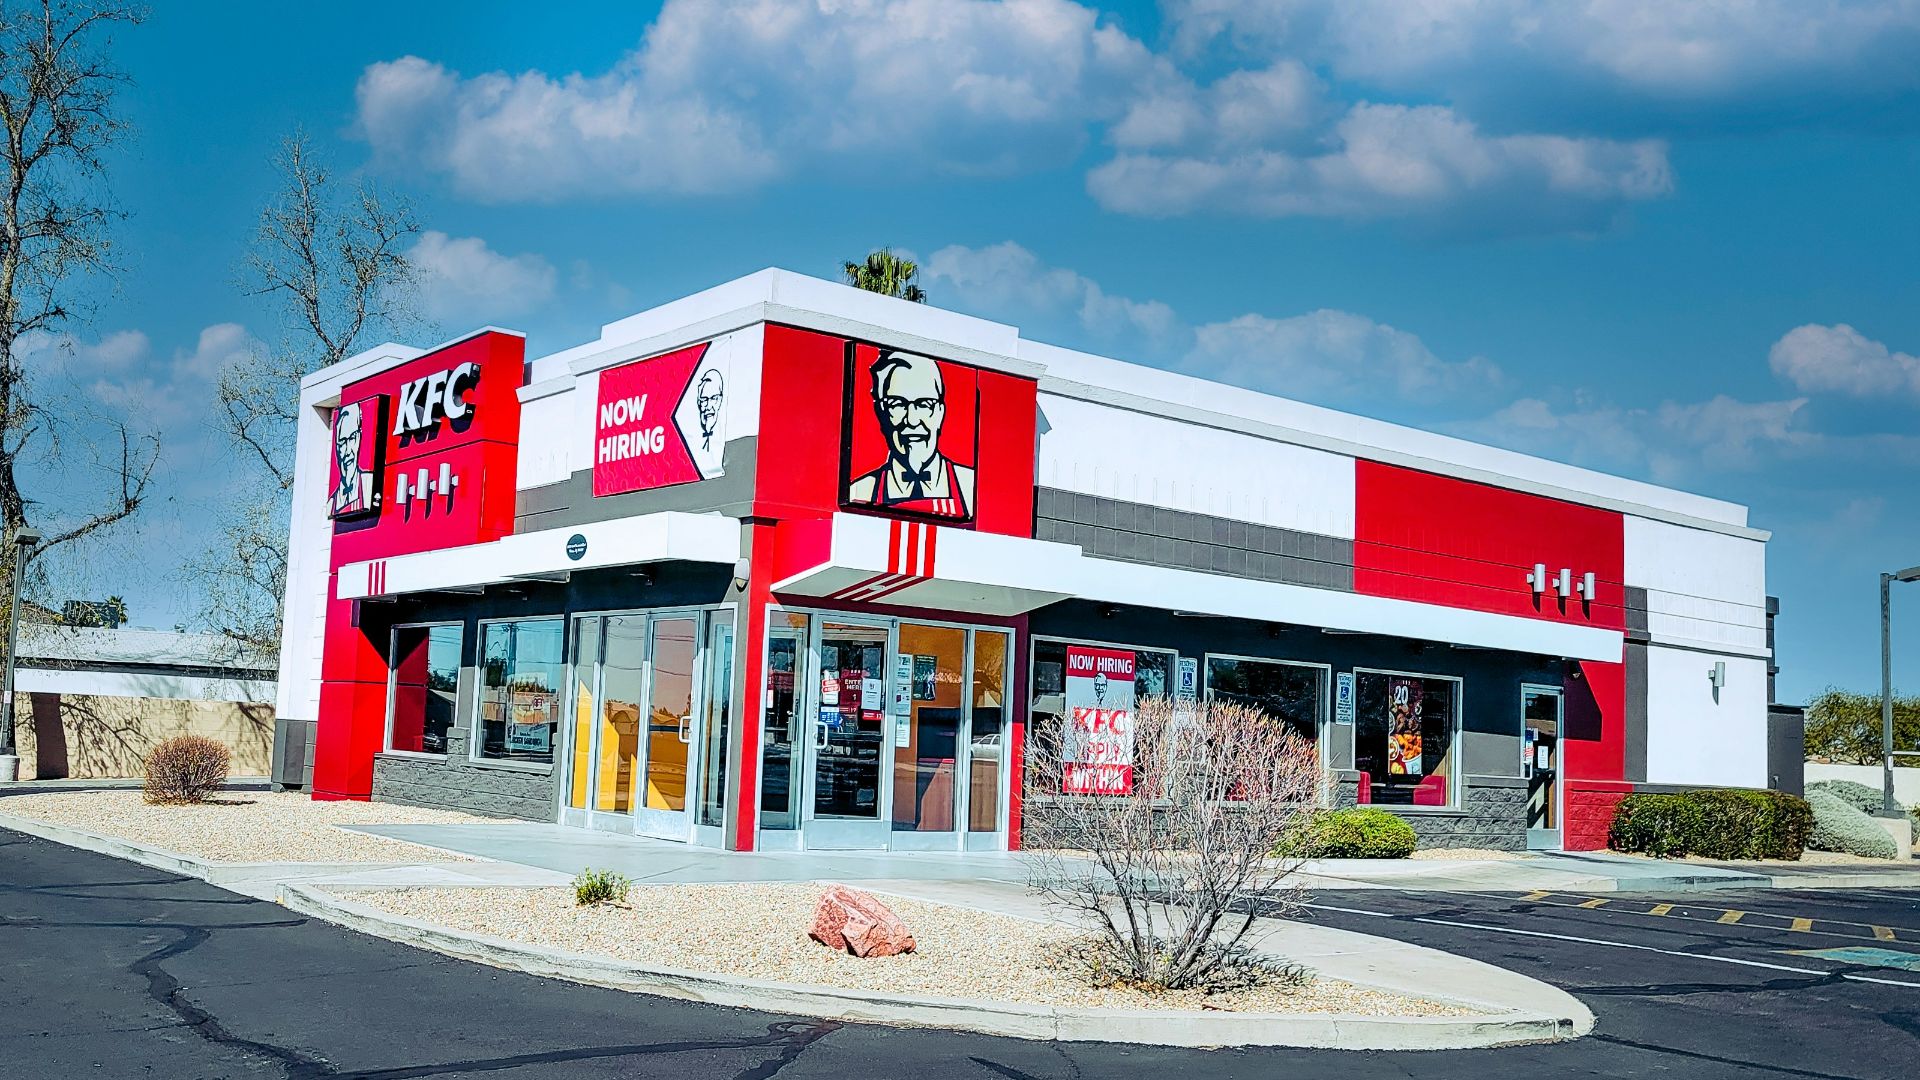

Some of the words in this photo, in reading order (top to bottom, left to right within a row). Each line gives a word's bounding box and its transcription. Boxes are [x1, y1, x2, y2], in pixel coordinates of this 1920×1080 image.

[393, 362, 473, 436] KFC
[600, 394, 648, 430] NOW
[598, 425, 665, 464] HIRING
[1069, 654, 1094, 671] NOW
[1096, 656, 1133, 674] HIRING
[1394, 685, 1408, 704] 20
[1073, 706, 1127, 735] KFC
